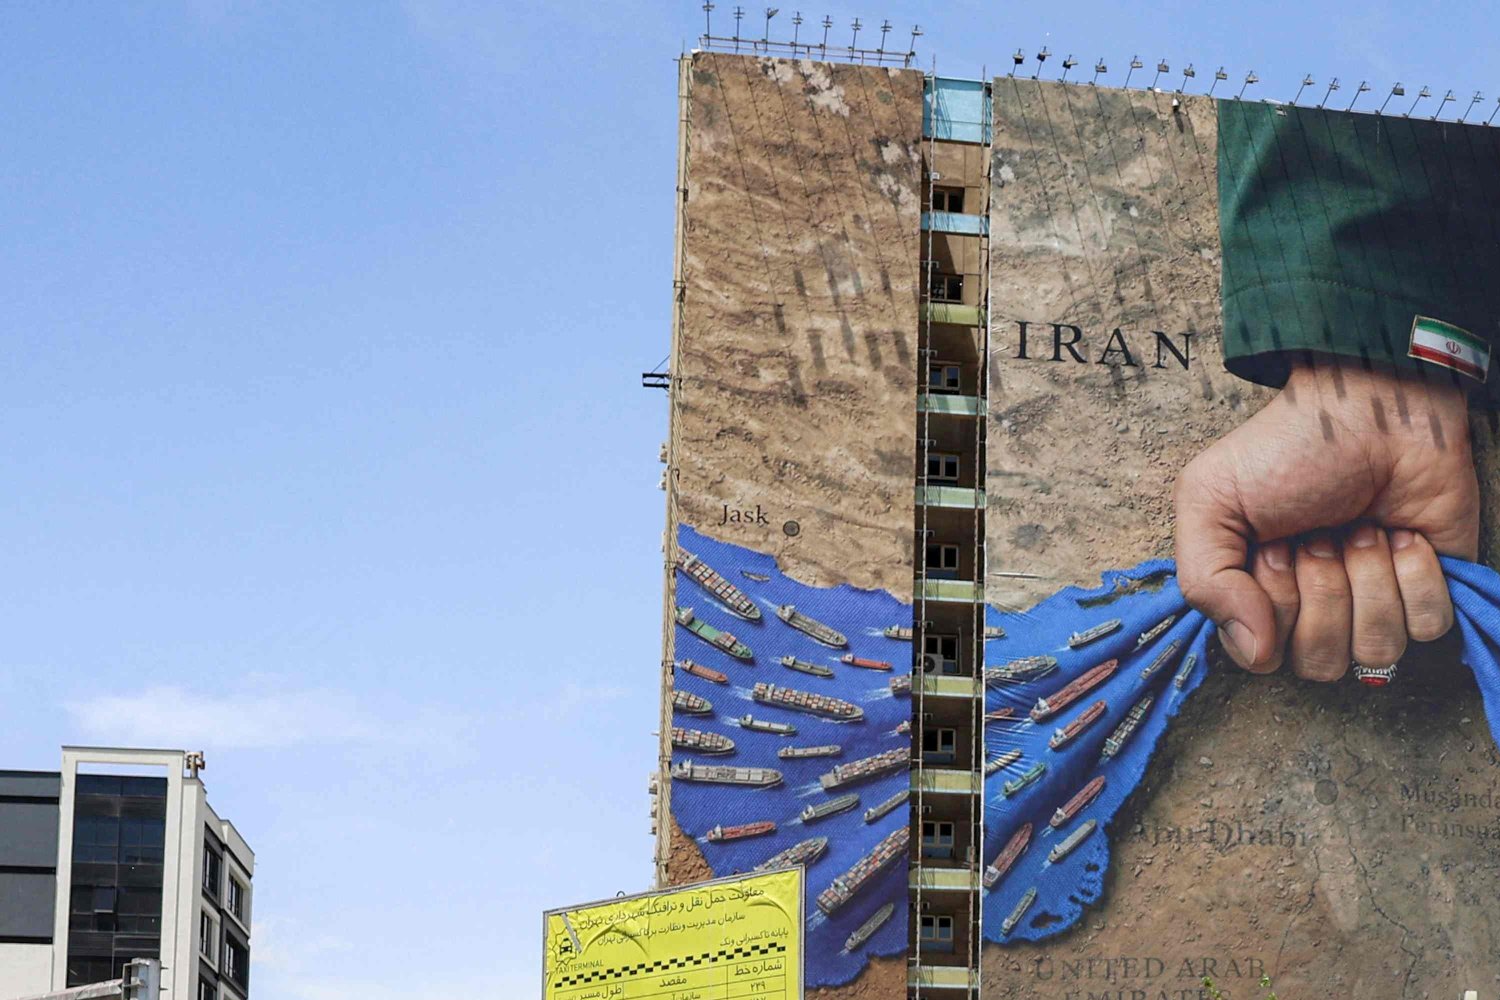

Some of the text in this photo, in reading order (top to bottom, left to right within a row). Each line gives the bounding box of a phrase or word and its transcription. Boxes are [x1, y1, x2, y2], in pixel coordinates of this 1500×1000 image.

[1013, 321, 1193, 370] IRAN
[718, 504, 769, 526] Jask
[734, 960, 783, 977] شماره خط
[1035, 957, 1265, 980] UNITED ARAB
[659, 976, 687, 988] مقصد
[601, 986, 623, 1000] طول
